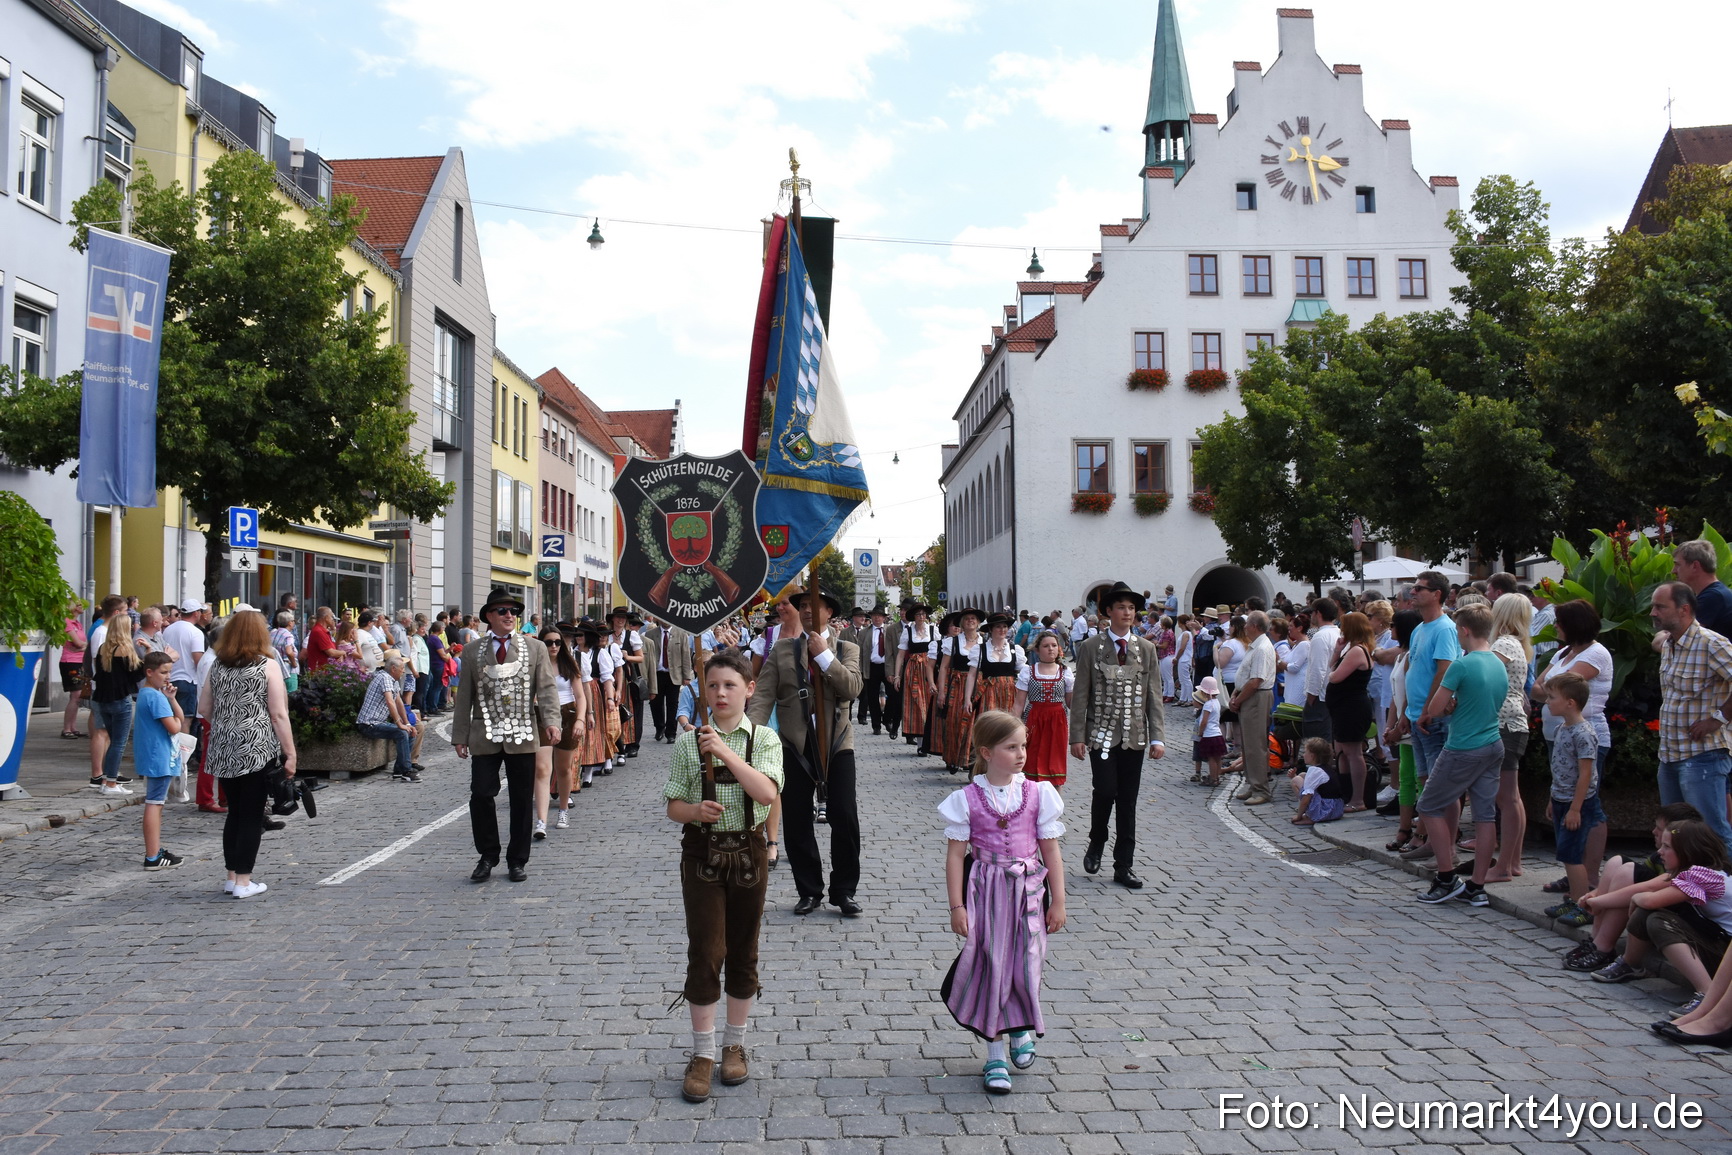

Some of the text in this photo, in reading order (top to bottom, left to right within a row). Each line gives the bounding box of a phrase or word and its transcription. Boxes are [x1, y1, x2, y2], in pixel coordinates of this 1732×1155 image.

[84, 360, 133, 375] Raiffeisenb
[84, 371, 126, 384] Neumarkt
[639, 461, 734, 489] SCHÜTZENGILDE
[674, 497, 701, 510] 1876
[236, 512, 252, 542] P
[666, 595, 728, 619] PYRBAUM
